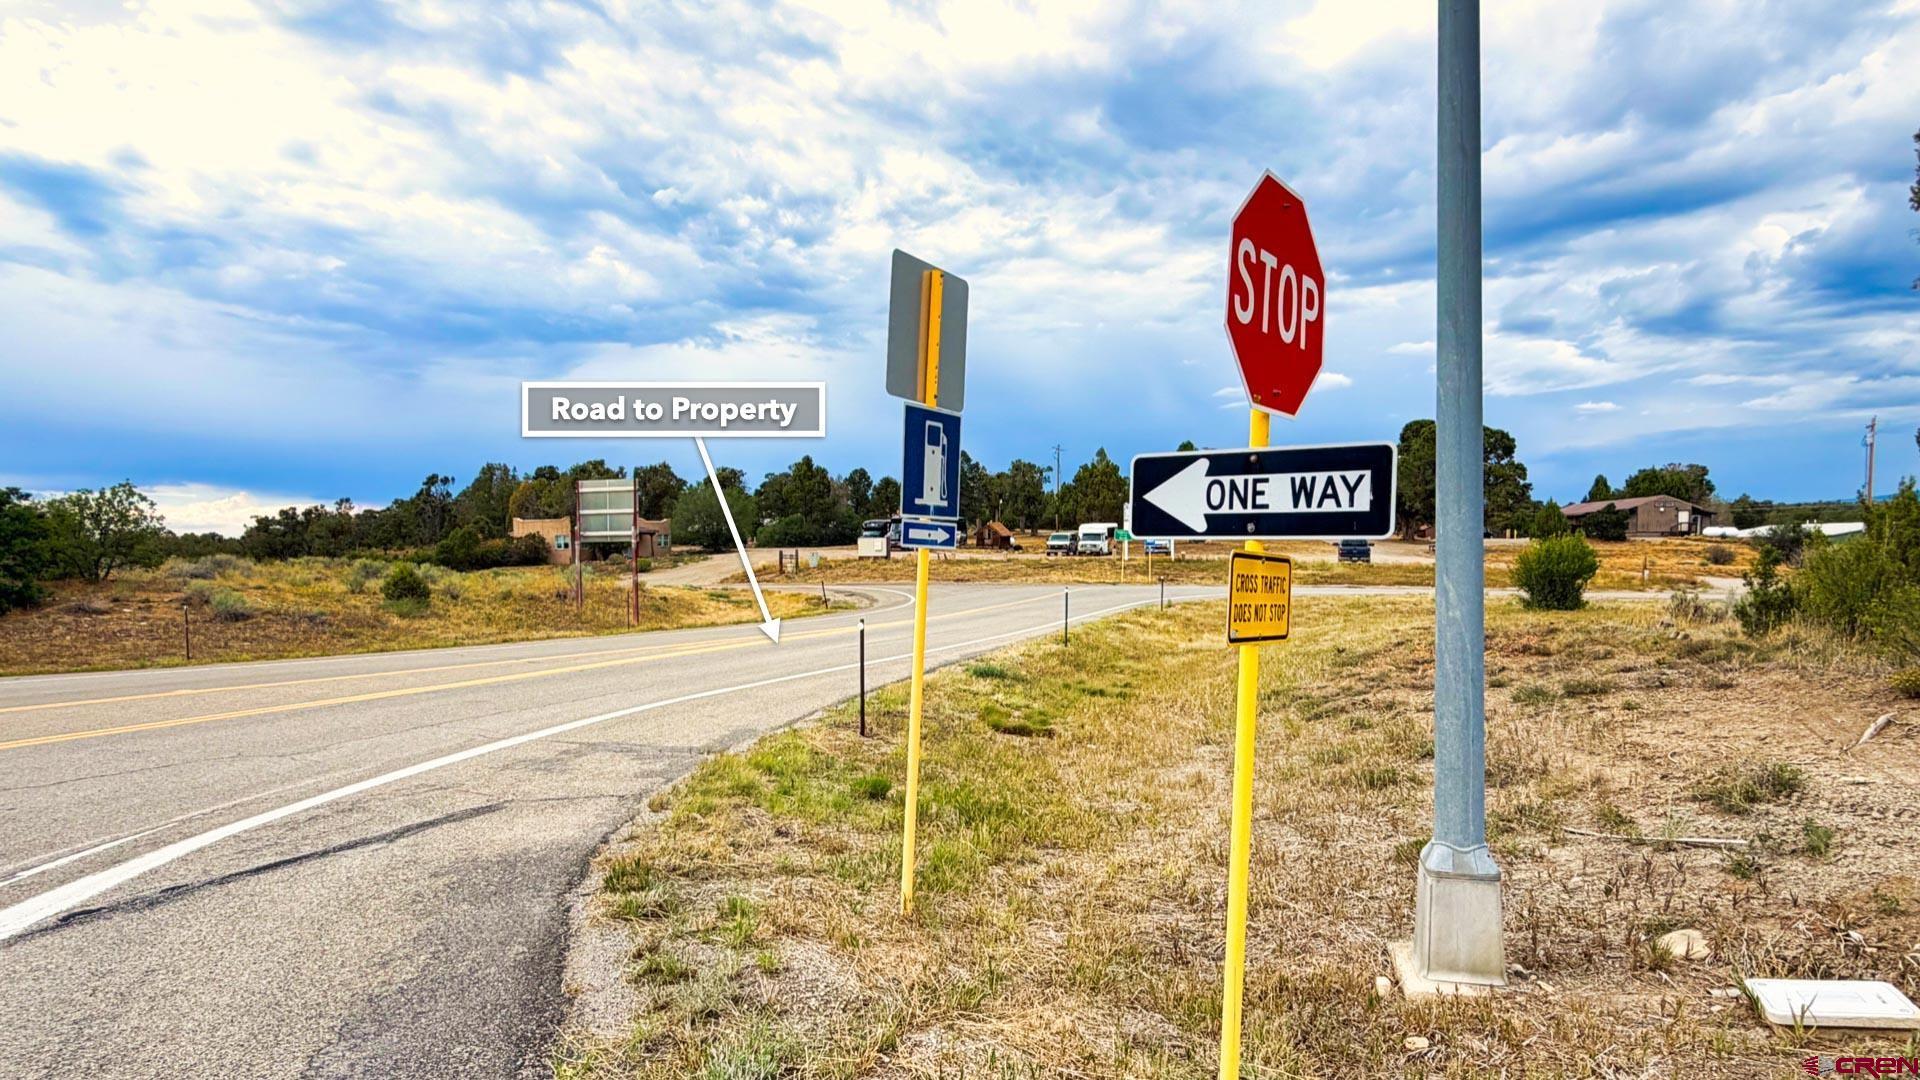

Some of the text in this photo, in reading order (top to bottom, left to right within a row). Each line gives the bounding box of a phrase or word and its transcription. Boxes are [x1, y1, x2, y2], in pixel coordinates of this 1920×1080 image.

[1234, 238, 1319, 350] STOP
[1206, 474, 1365, 511] ONE WAY
[1235, 573, 1287, 594] CROSS TRAFFIC
[1233, 603, 1286, 622] DOES NOT STOP
